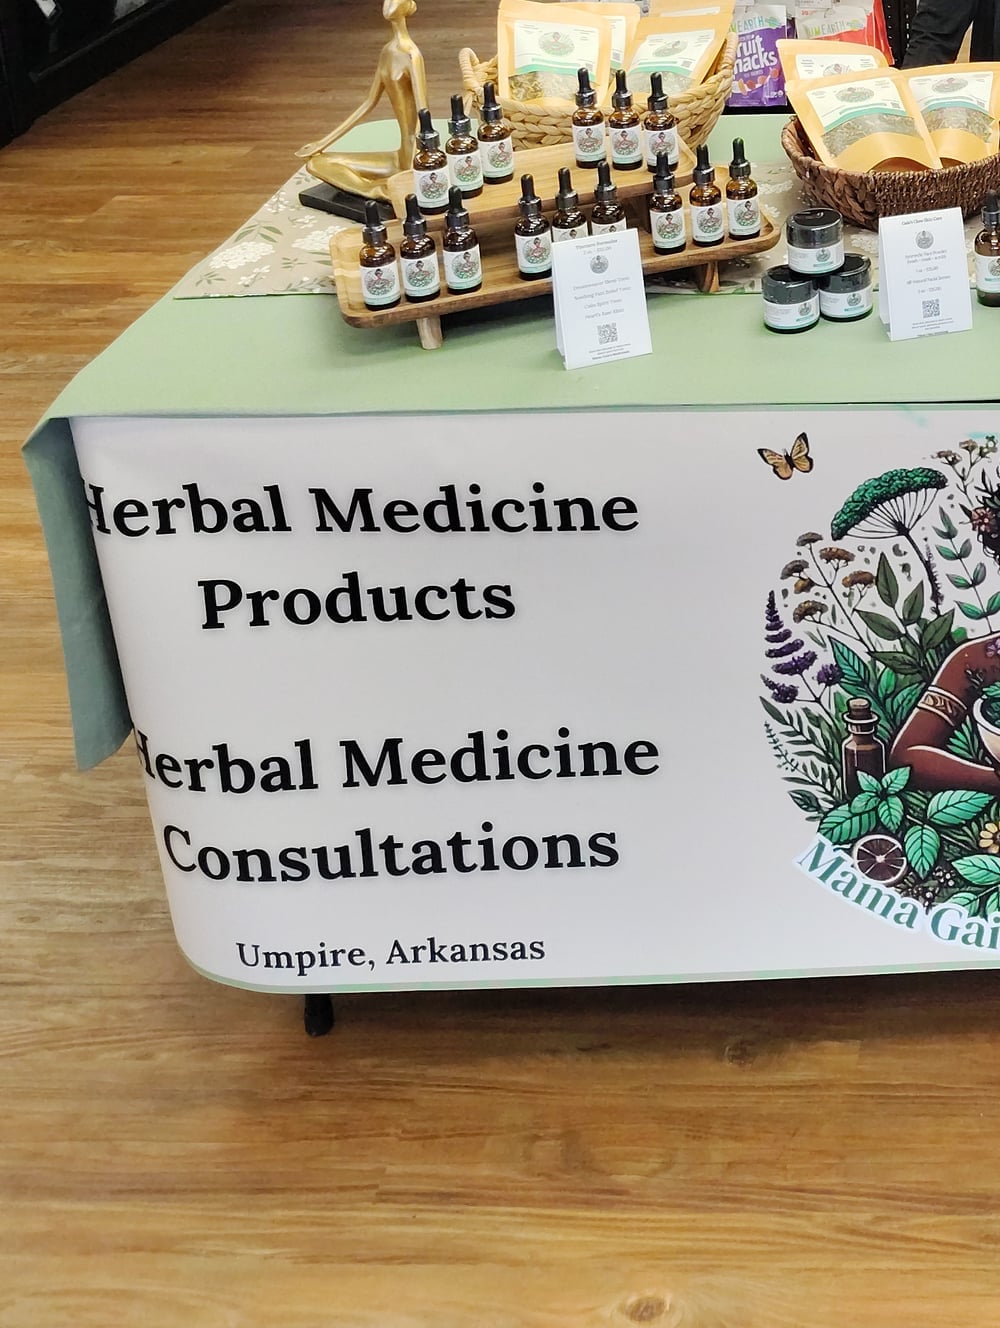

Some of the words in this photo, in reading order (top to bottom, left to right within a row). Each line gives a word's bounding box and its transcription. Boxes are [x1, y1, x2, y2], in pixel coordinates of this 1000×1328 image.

[309, 482, 639, 532] Medicine
[198, 571, 516, 630] Products
[340, 727, 660, 788] Medicine
[163, 821, 619, 882] Consultations
[798, 841, 920, 930] Mama
[236, 942, 375, 976] Umpire,
[386, 936, 545, 965] Arkansas
